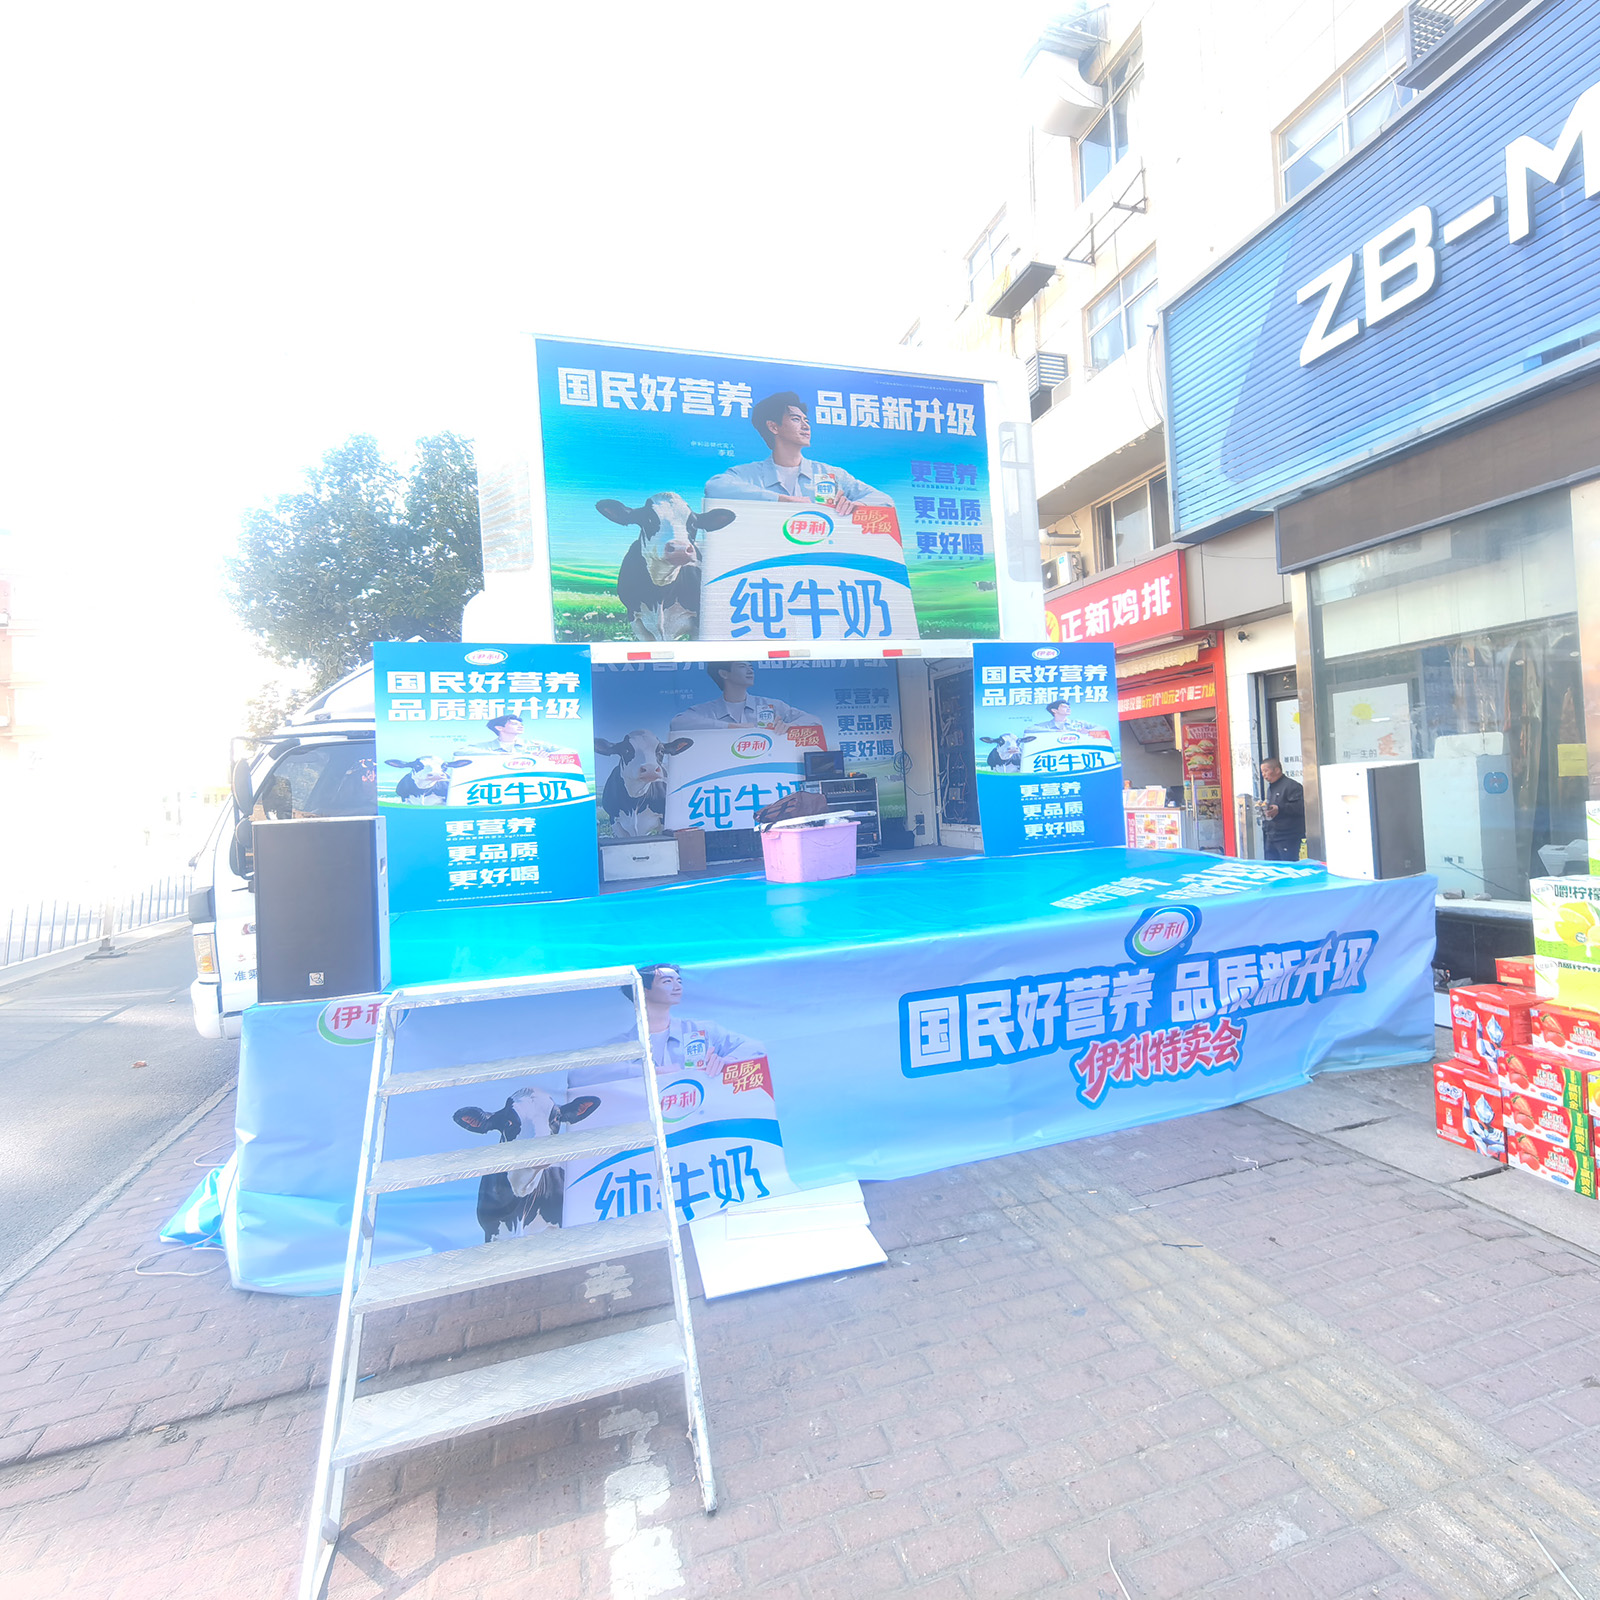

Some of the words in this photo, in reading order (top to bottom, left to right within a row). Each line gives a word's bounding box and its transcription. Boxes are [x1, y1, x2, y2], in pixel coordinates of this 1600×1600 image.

[558, 366, 753, 418] 国民好营养
[815, 390, 977, 436] 品质新升级
[911, 461, 978, 485] 更营养
[853, 509, 883, 522] 品质
[914, 496, 982, 521] 更品质
[789, 519, 827, 541] 伊利
[863, 521, 892, 534] 升级
[916, 531, 984, 555] 更好喝
[729, 576, 893, 639] 纯牛奶
[1061, 575, 1172, 642] 正新鸡排
[387, 671, 581, 693] 国民好营养
[982, 664, 1108, 684] 国民好营养
[834, 688, 889, 705] 更营养
[982, 685, 1109, 706] 品质新升级
[388, 696, 581, 721] 品质新升级
[837, 714, 893, 731] 更品质
[789, 729, 814, 740] 品质
[796, 736, 820, 747] 升级
[737, 740, 767, 752] 伊利
[839, 740, 894, 757] 更好喝
[1033, 752, 1106, 773] 纯牛奶
[467, 780, 573, 806] 纯牛奶
[1020, 781, 1081, 798] 更营养
[1022, 801, 1083, 818] 更品质
[445, 817, 537, 837] 更营养
[1024, 820, 1085, 838] 更好喝
[448, 841, 538, 862] 更品质
[449, 865, 540, 887] 更好喝
[1141, 920, 1185, 942] 伊利
[907, 968, 1155, 1069] 国民好营养
[1170, 938, 1373, 1022] 品质新升级
[724, 1060, 755, 1080] 品质
[1077, 1017, 1244, 1102] 伊利特卖会
[733, 1072, 764, 1094] 升级
[660, 1089, 697, 1111] 伊利
